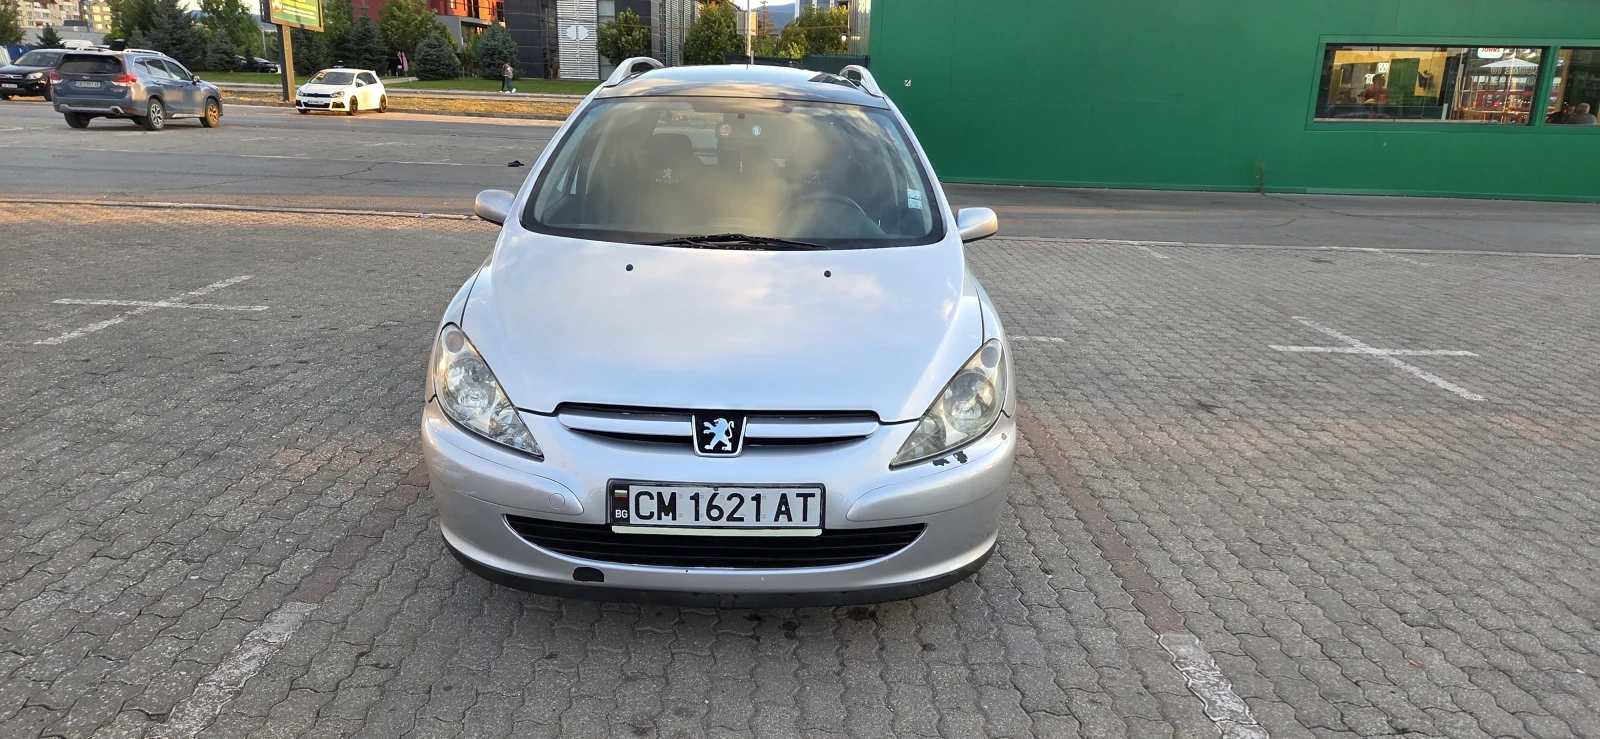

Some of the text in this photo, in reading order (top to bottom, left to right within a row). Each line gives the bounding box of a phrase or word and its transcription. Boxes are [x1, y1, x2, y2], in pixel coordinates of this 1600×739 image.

[615, 509, 628, 519] BG
[634, 491, 816, 523] CM 1621 AT
